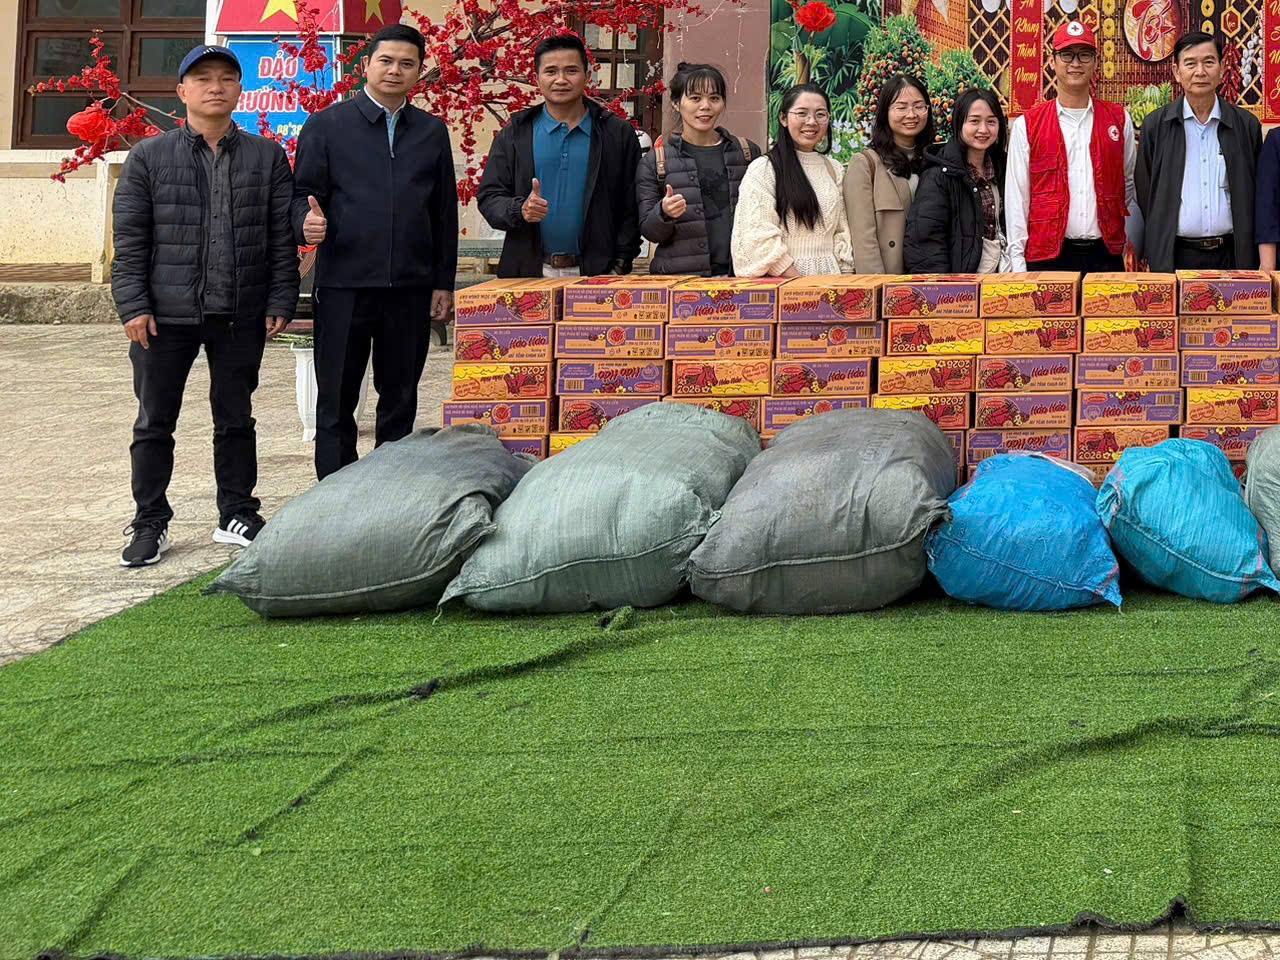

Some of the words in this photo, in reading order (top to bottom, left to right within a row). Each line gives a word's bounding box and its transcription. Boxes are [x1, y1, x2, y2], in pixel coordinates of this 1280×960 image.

[1014, 17, 1040, 38] Khang
[259, 50, 299, 78] ĐẢO
[677, 385, 700, 394] 2026
[1079, 452, 1101, 460] 2026
